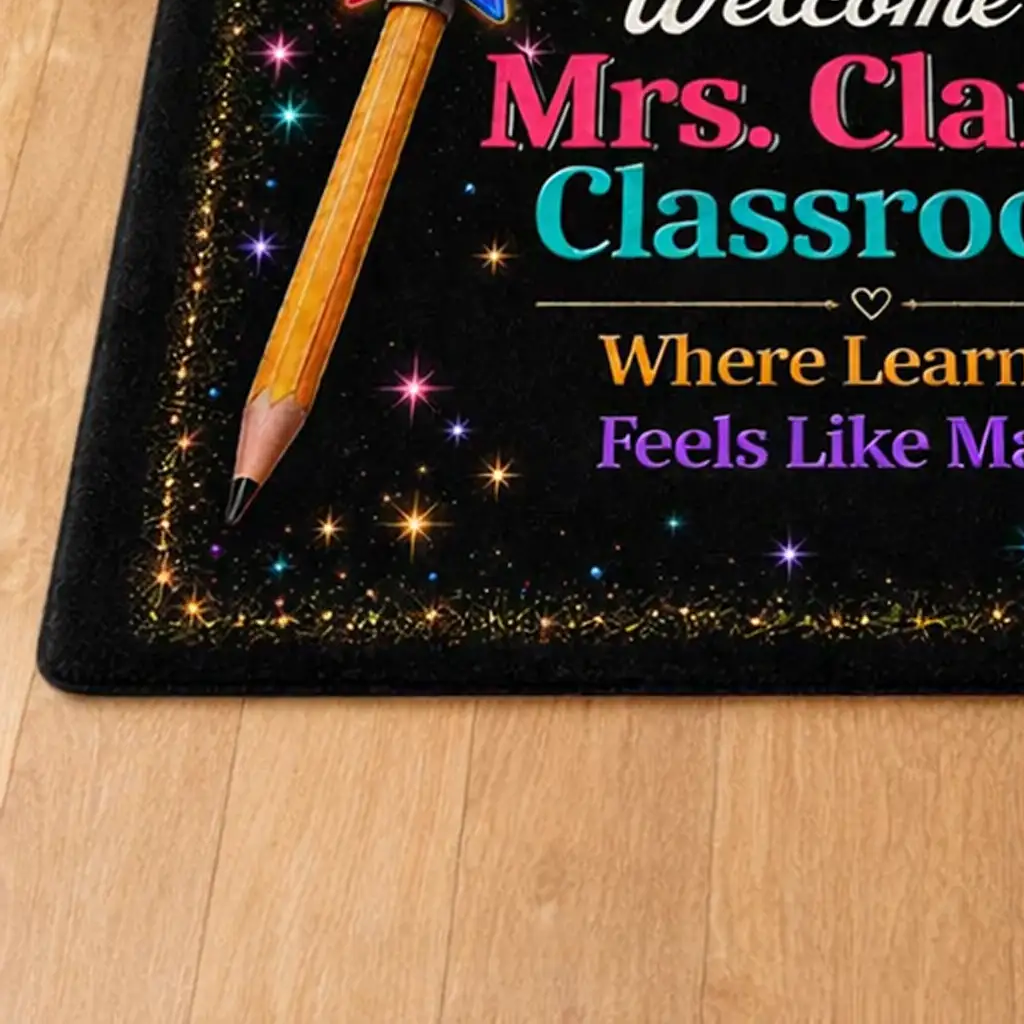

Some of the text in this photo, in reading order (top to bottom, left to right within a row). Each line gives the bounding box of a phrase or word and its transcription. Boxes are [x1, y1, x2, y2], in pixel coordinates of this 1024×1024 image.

[480, 52, 780, 152] Mrs.
[599, 333, 826, 387] Where
[597, 414, 769, 469] Feels
[786, 413, 930, 469] Like
